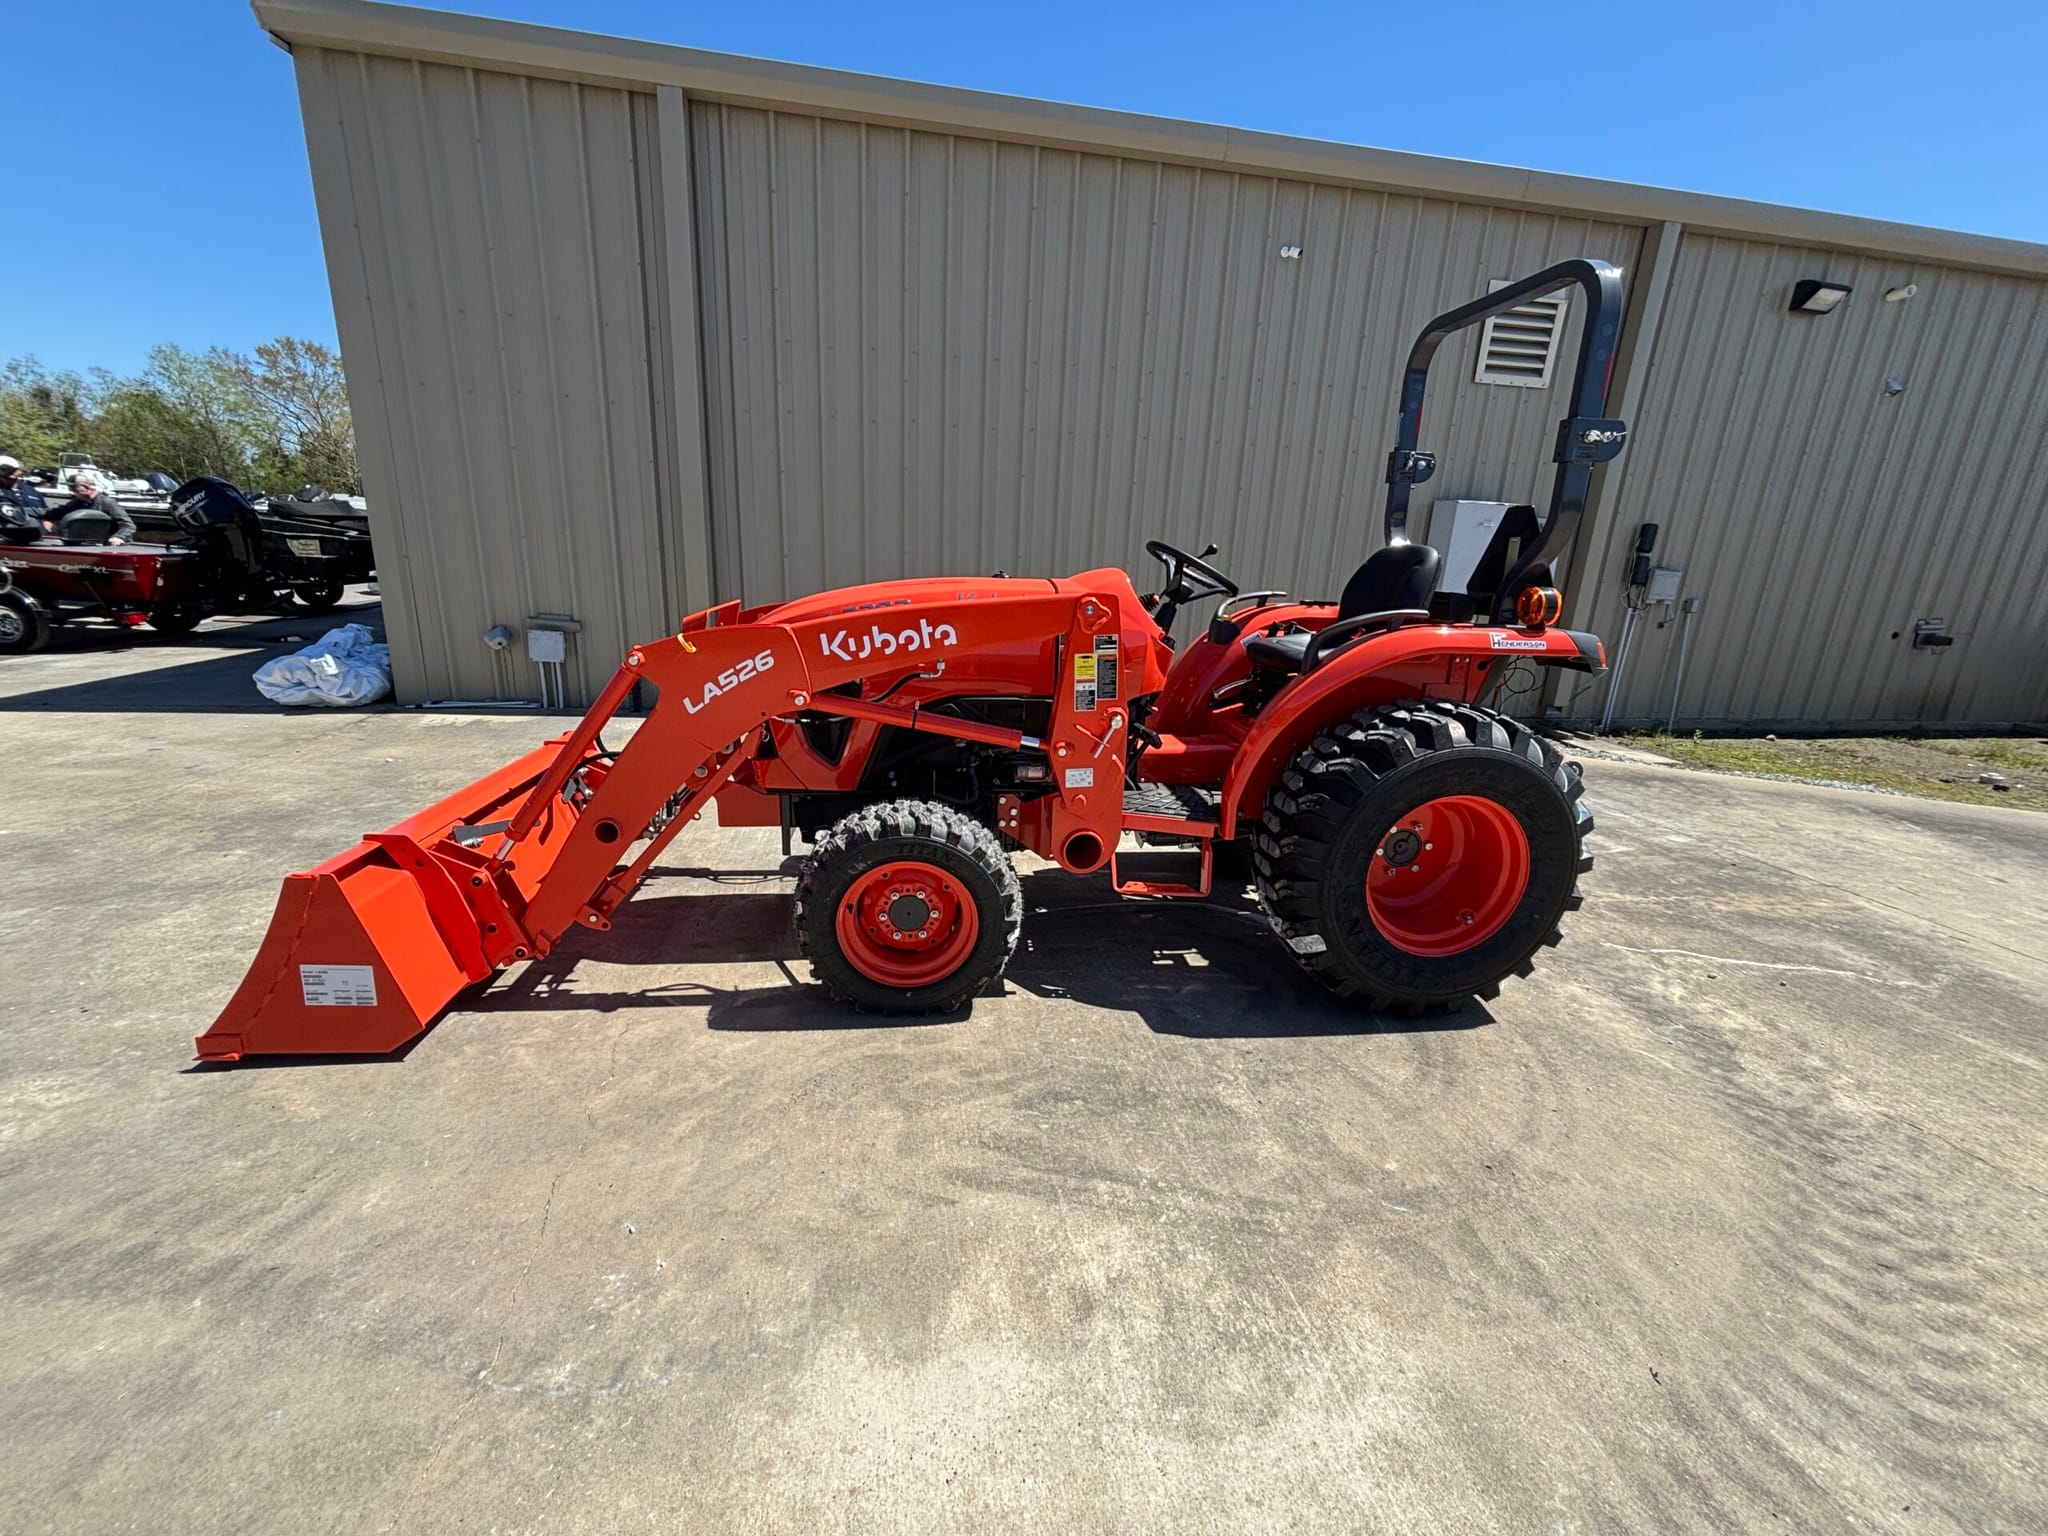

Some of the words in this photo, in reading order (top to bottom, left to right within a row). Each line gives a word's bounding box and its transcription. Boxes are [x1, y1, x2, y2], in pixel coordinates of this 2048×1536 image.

[820, 618, 957, 661] Kubota
[682, 649, 774, 714] LA526
[896, 842, 954, 863] TITAN
